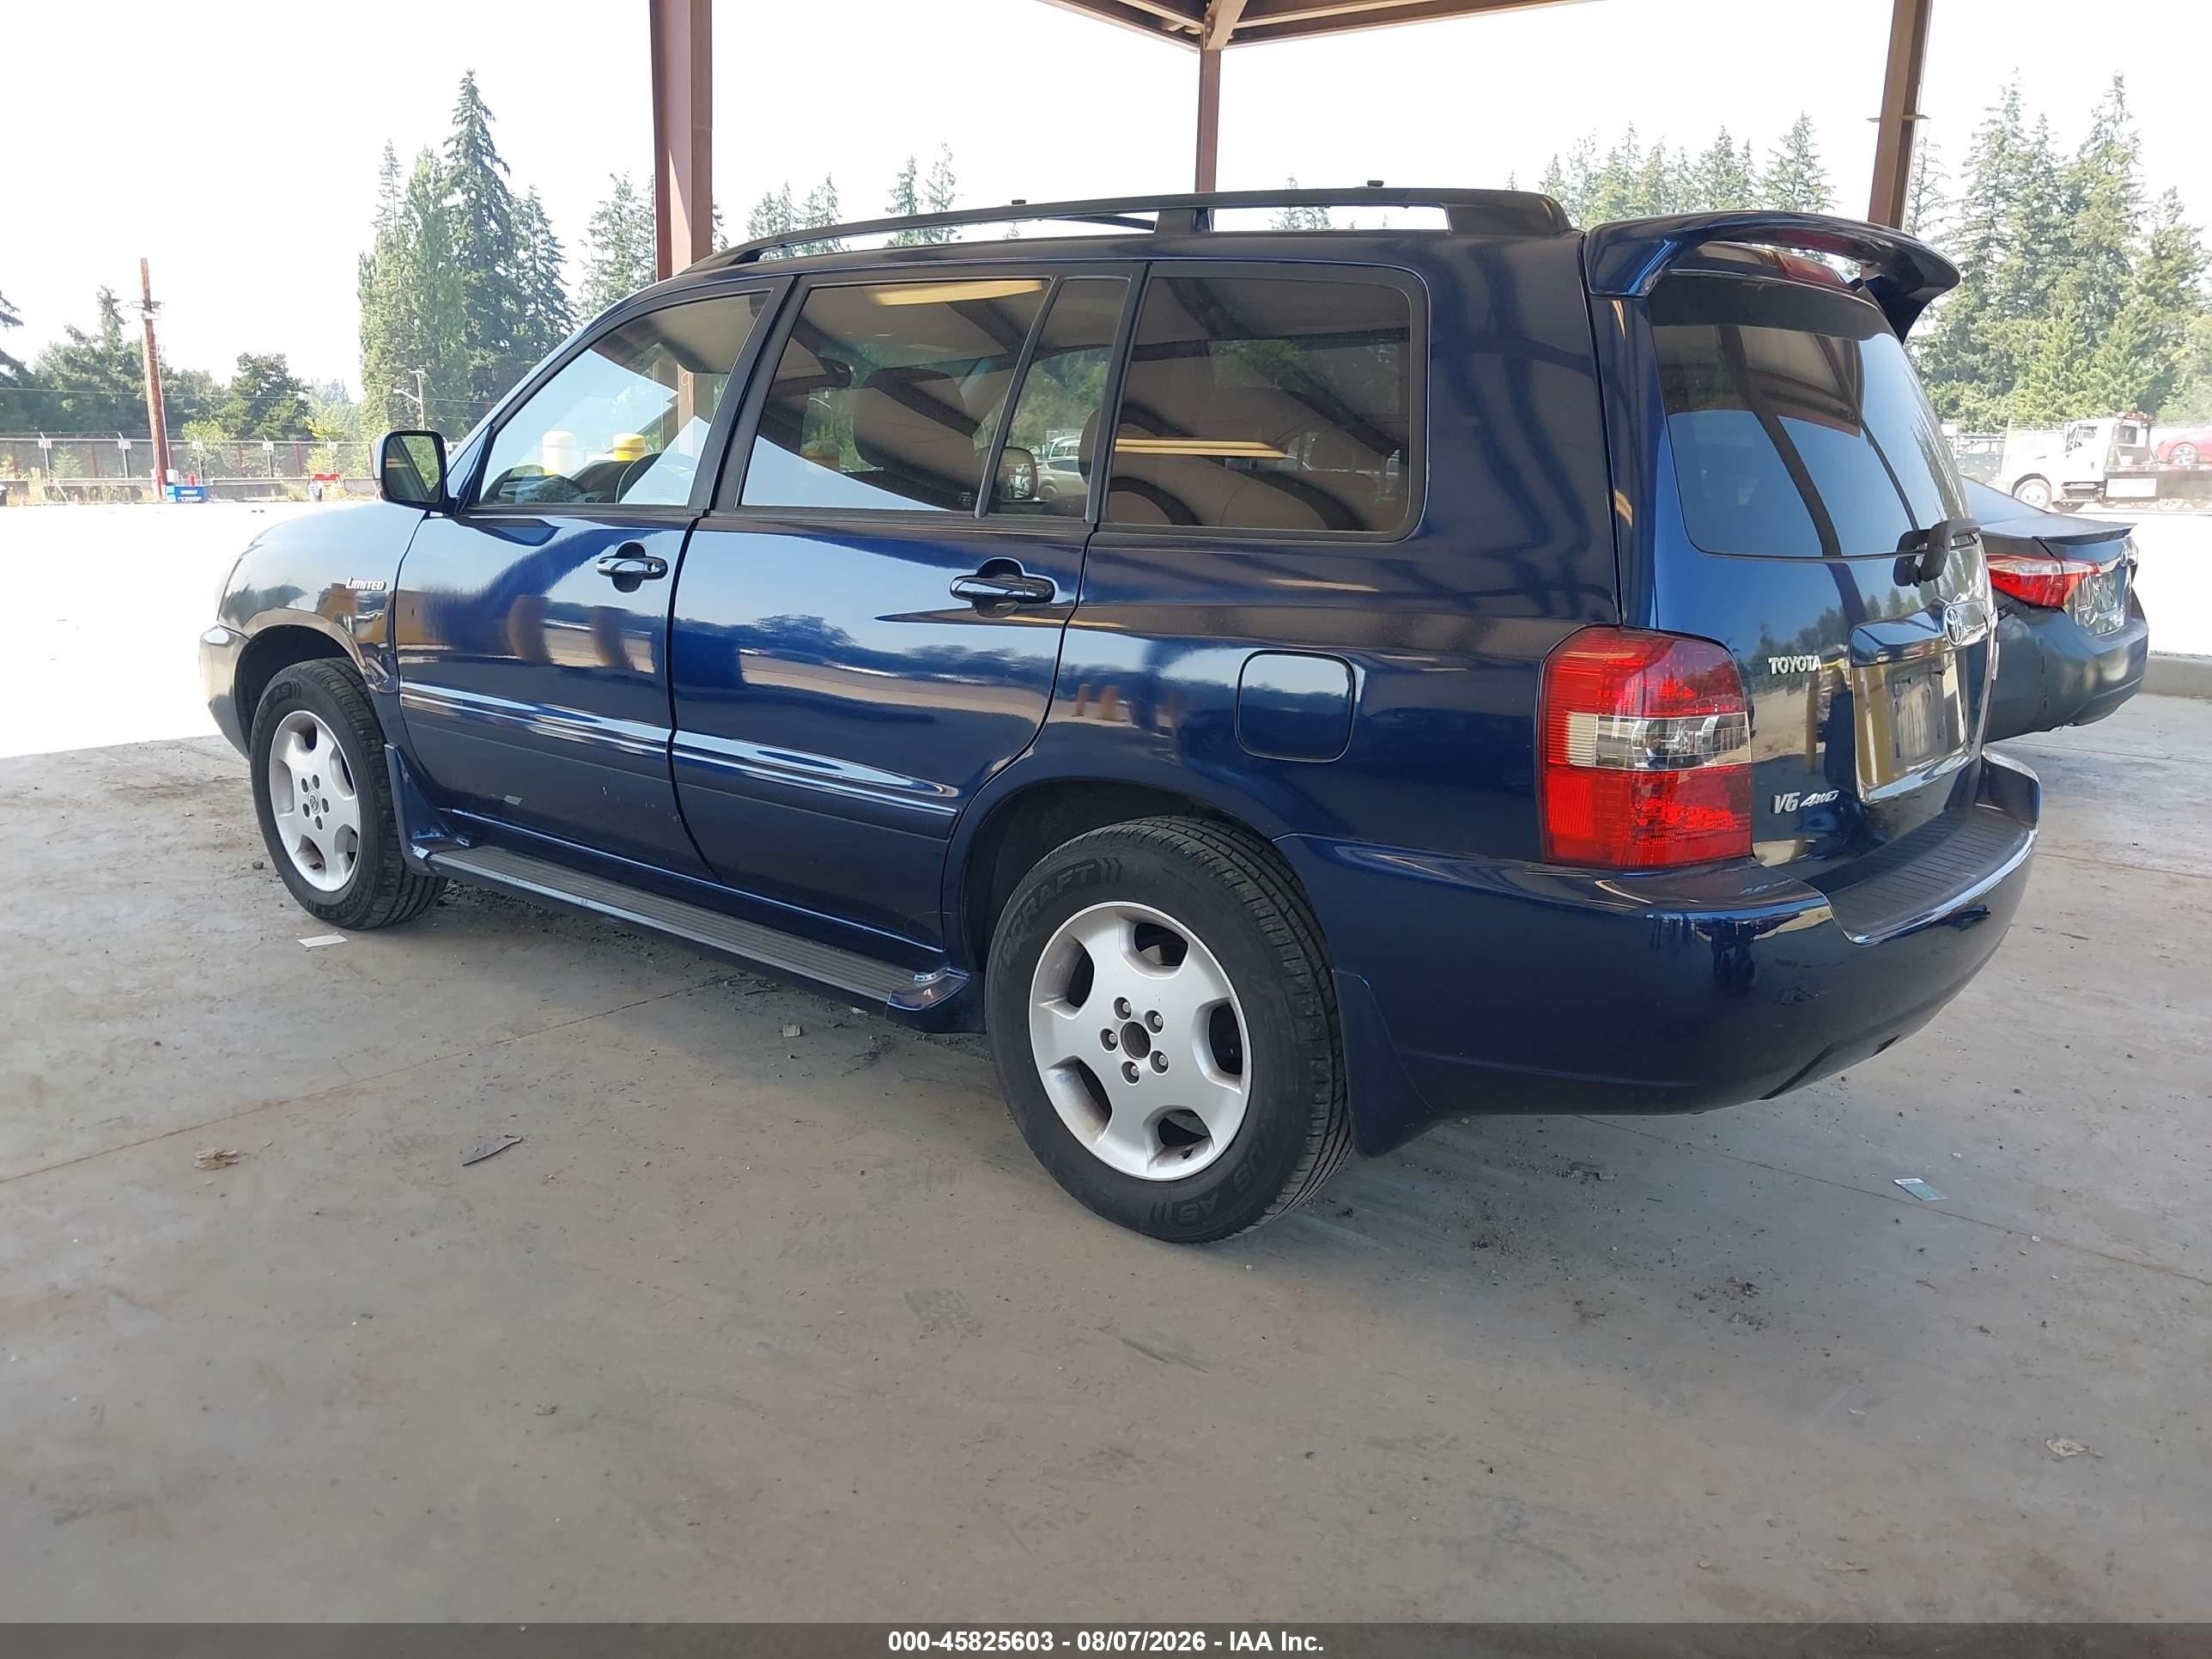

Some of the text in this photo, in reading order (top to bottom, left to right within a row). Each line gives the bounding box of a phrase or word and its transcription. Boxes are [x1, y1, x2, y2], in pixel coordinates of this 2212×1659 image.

[345, 577, 386, 591] LIMITED
[1768, 655, 1822, 675] TOYOTA
[1773, 792, 1801, 814] V6
